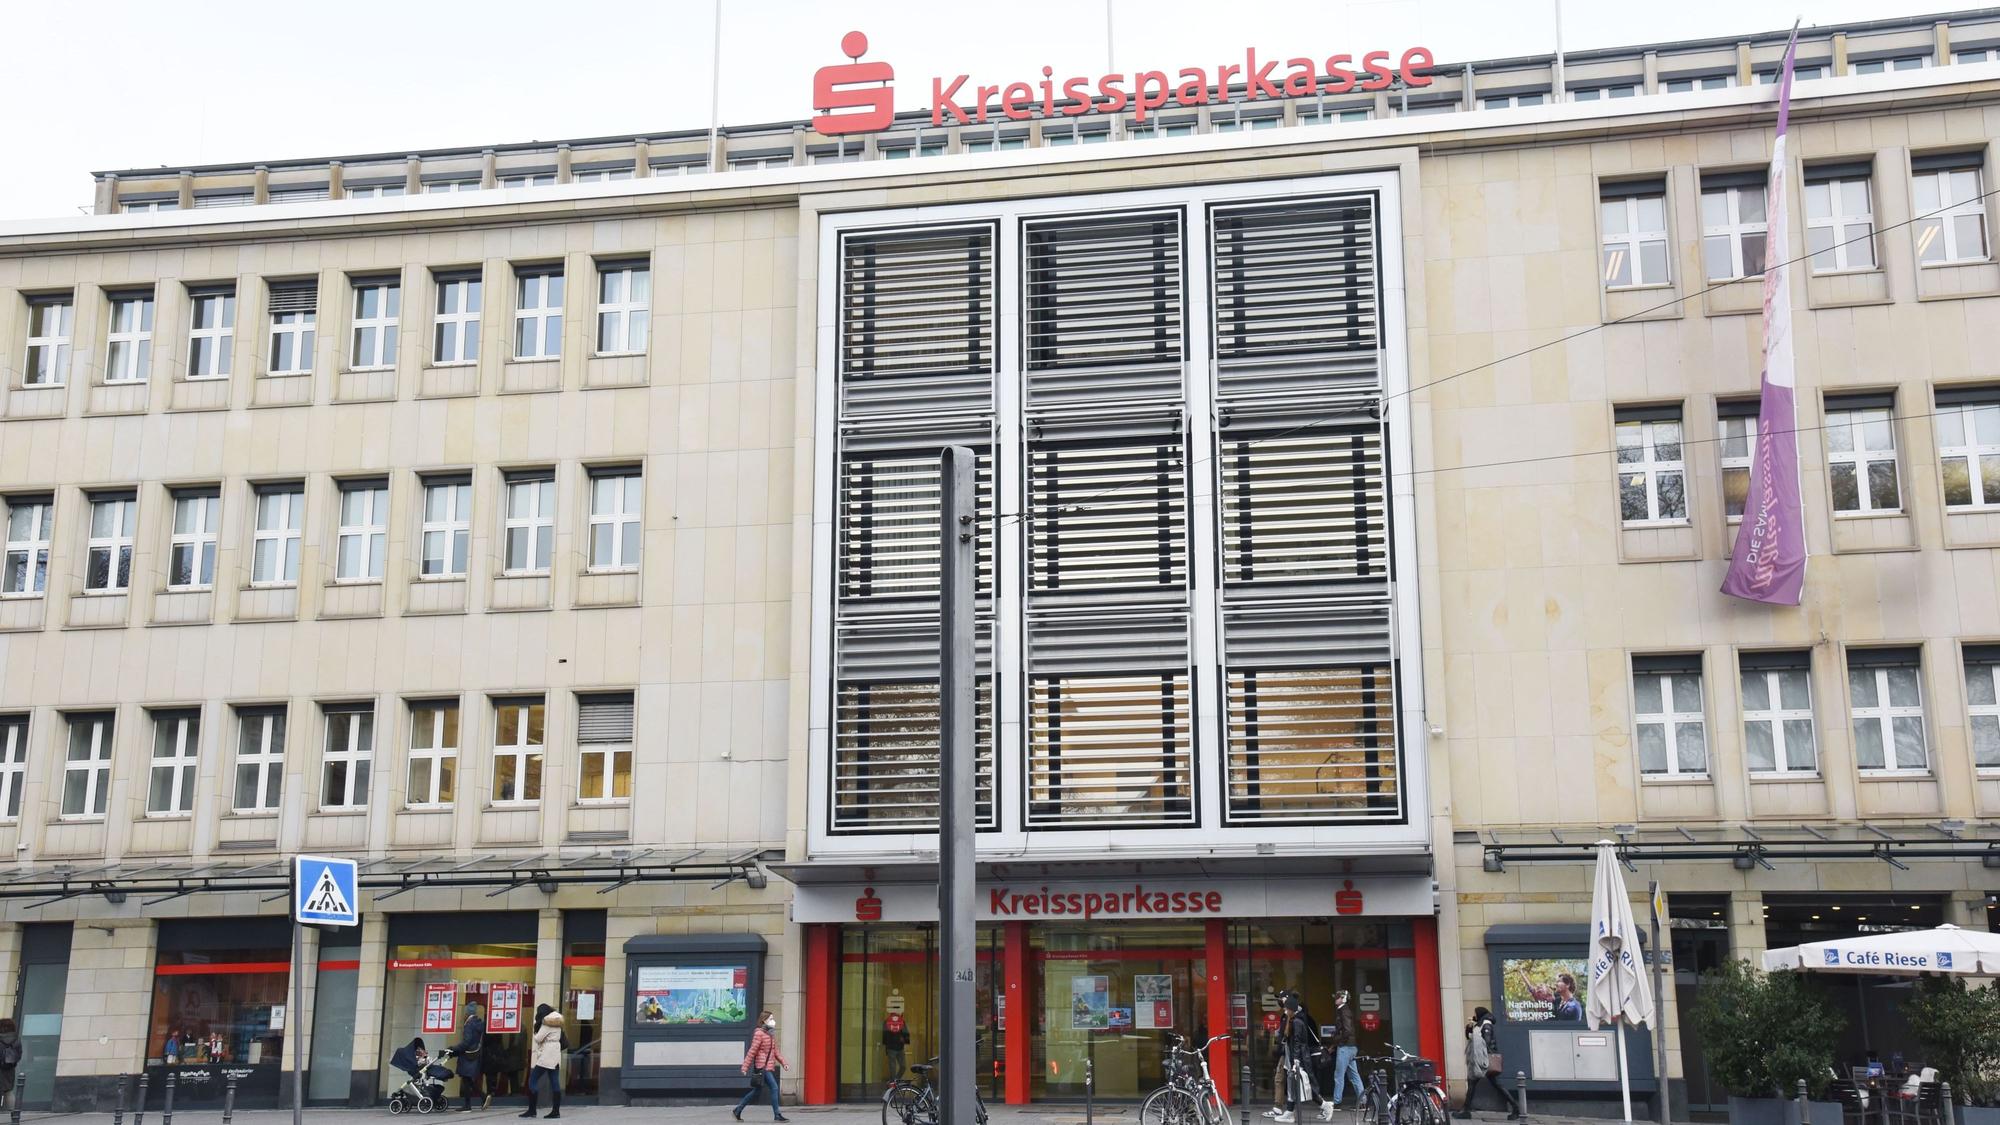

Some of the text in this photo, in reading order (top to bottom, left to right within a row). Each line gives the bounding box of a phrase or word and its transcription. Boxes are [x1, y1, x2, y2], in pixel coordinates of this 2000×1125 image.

[931, 46, 1435, 126] Kreissparkasse
[990, 885, 1223, 920] Kreissparkasse
[1846, 951, 1927, 967] Café Riese
[956, 969, 973, 982] 348
[1508, 1000, 1553, 1011] Nachhaltig
[1508, 1010, 1556, 1020] unterwegs.
